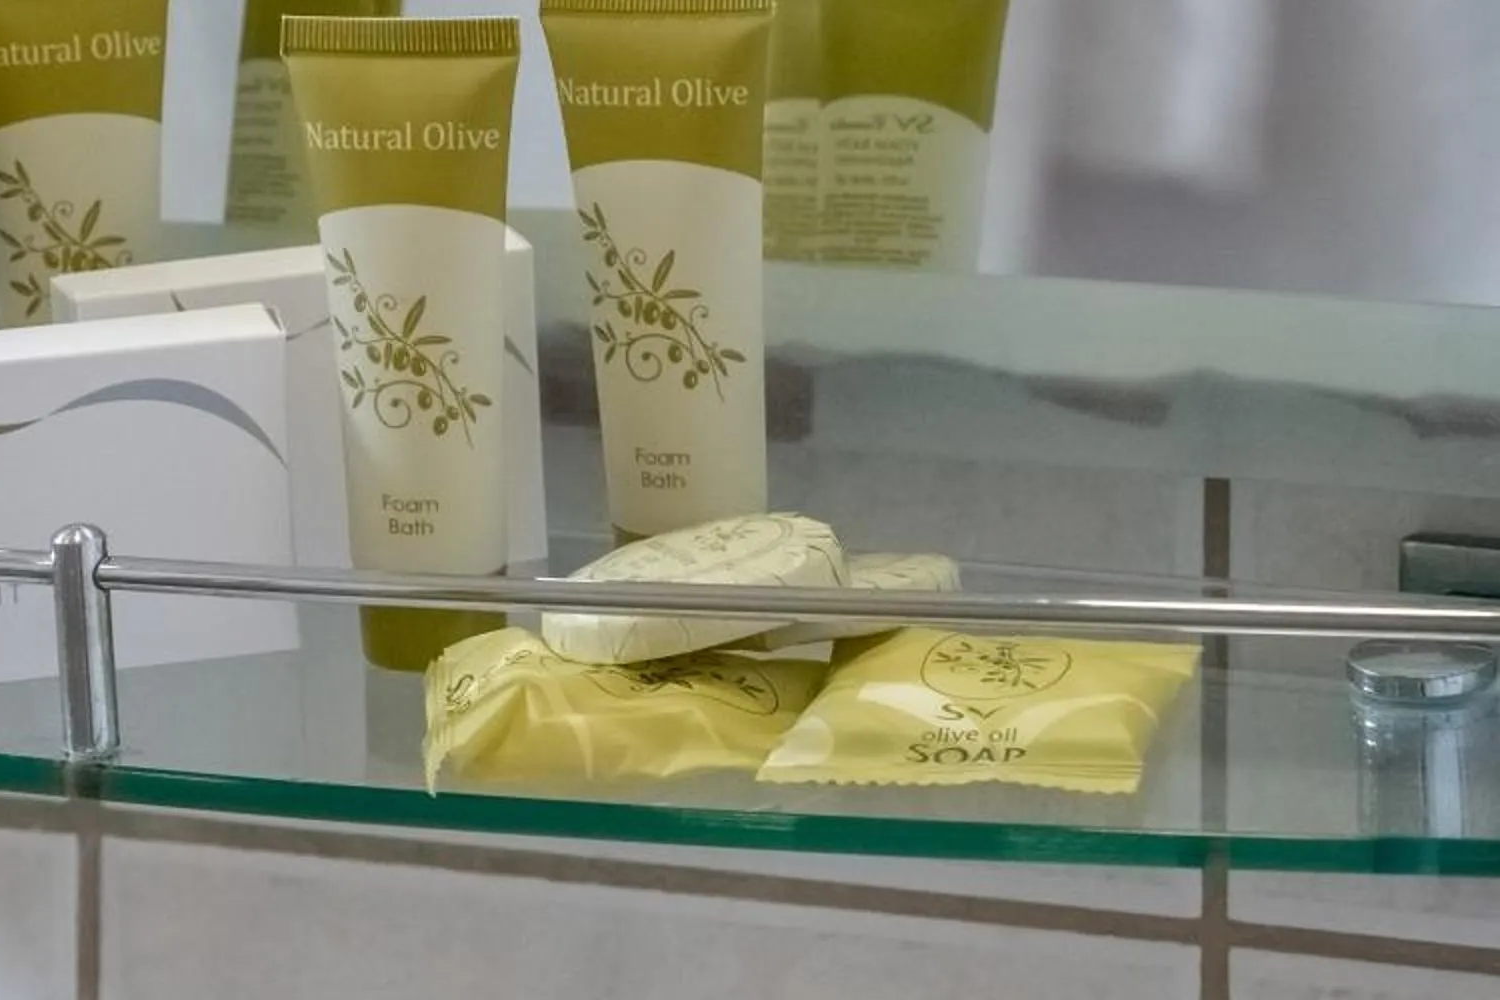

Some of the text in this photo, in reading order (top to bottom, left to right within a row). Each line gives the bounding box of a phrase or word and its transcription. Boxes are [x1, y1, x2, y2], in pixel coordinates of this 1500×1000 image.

[90, 30, 163, 60] Olive
[557, 77, 749, 107] Natural Olive
[305, 121, 500, 152] Natural Olive
[635, 447, 691, 466] Foam
[641, 472, 687, 489] Bath
[382, 493, 439, 513] Foam
[389, 517, 435, 536] Bath
[921, 727, 1018, 743] olive oil
[905, 743, 1027, 763] SOAP
